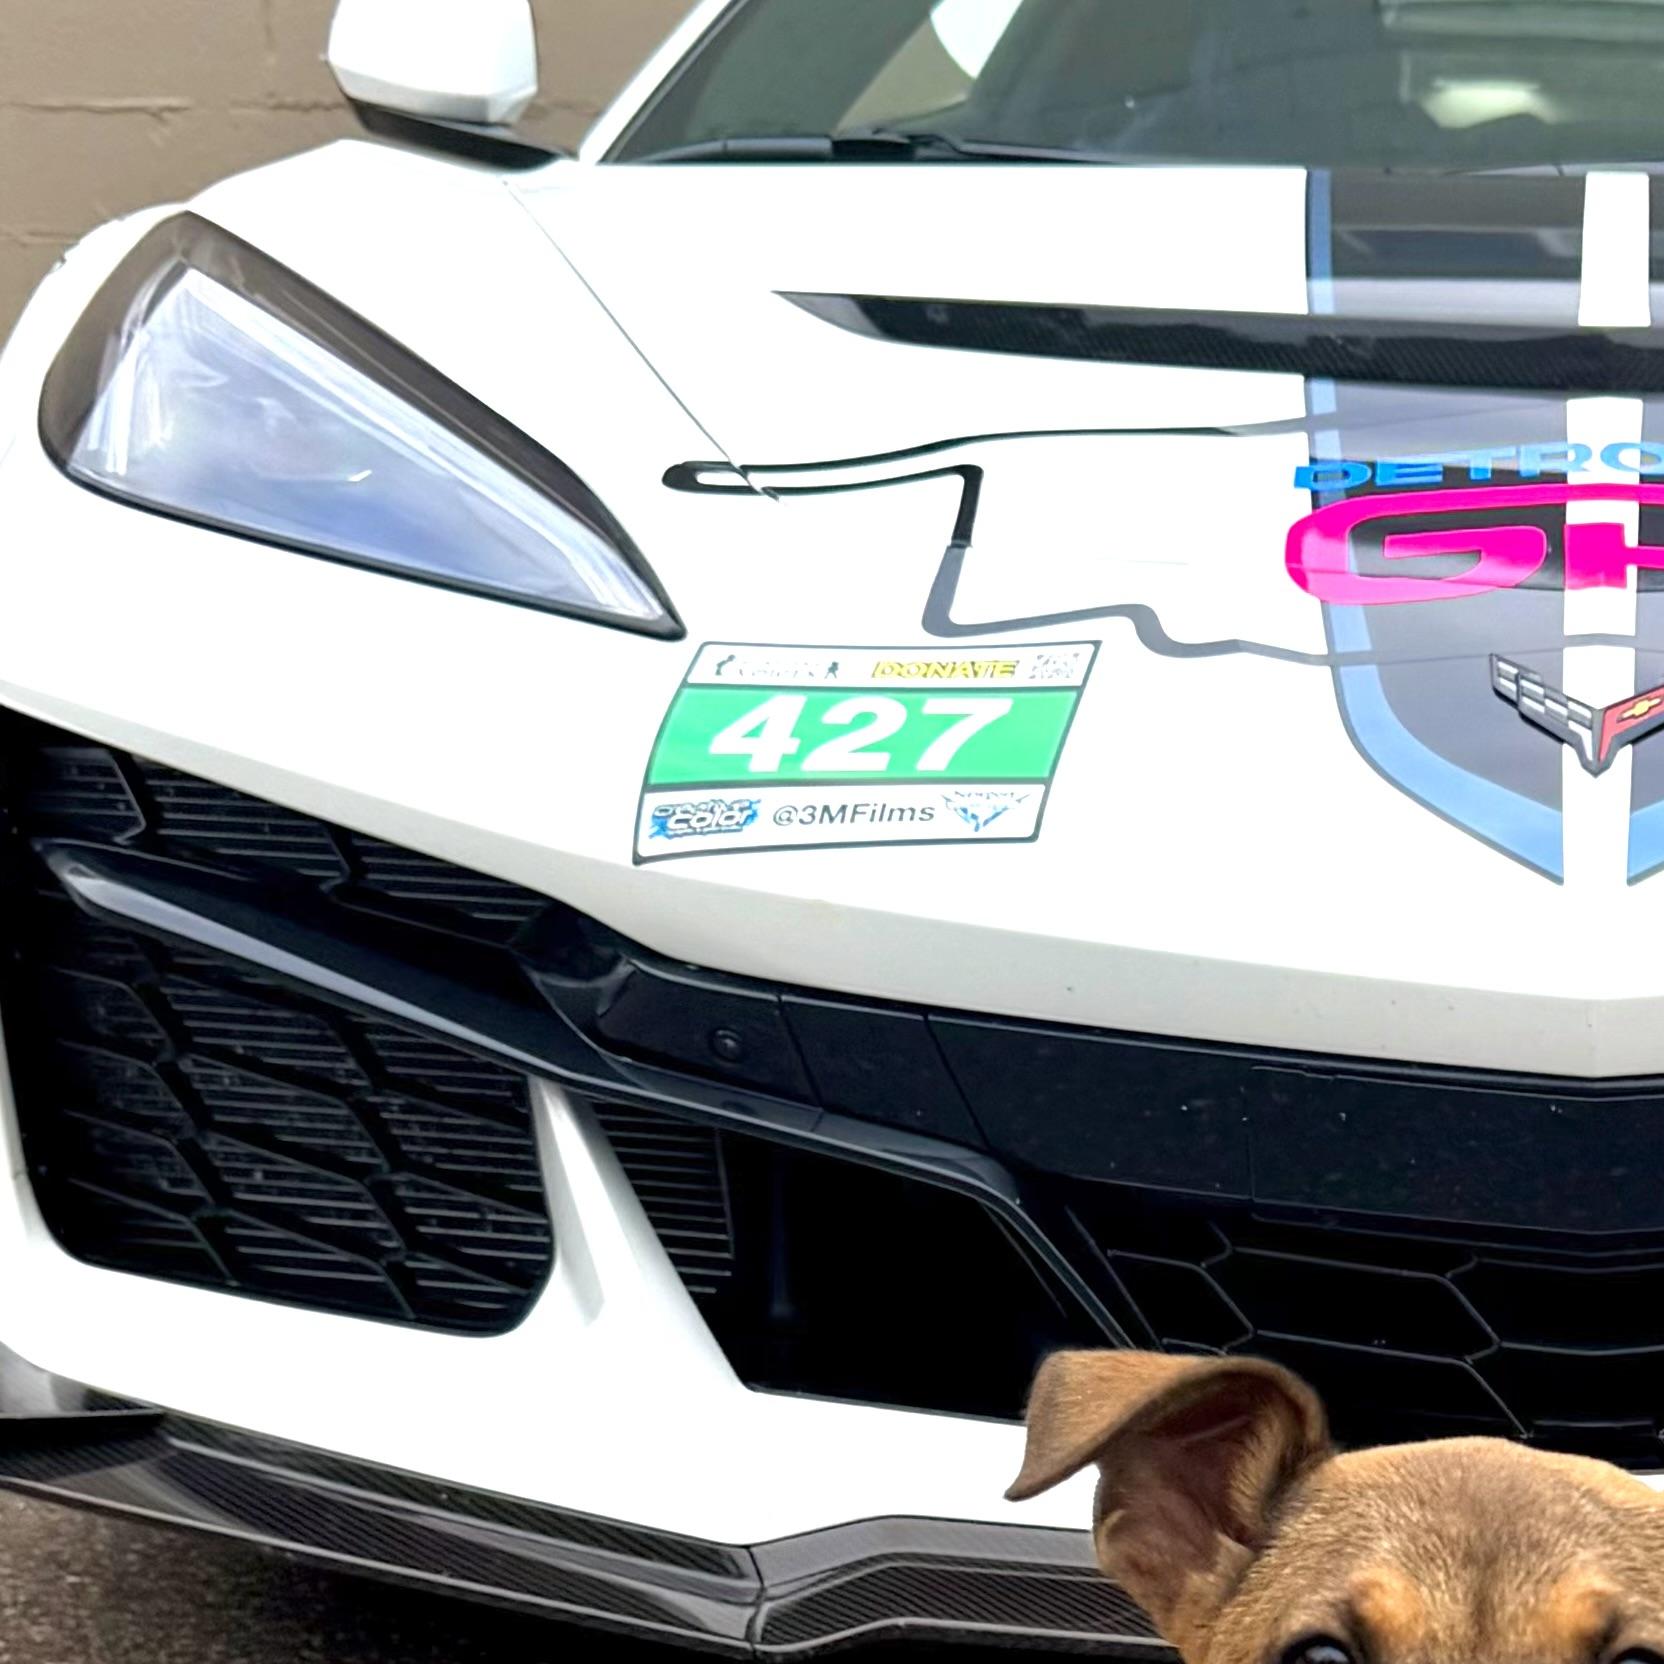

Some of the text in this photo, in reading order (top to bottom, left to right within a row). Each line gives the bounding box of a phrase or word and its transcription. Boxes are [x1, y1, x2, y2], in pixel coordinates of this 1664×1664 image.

[871, 659, 1020, 679] DONATE
[708, 694, 1014, 773] 427
[772, 802, 936, 827] @3MFilms
